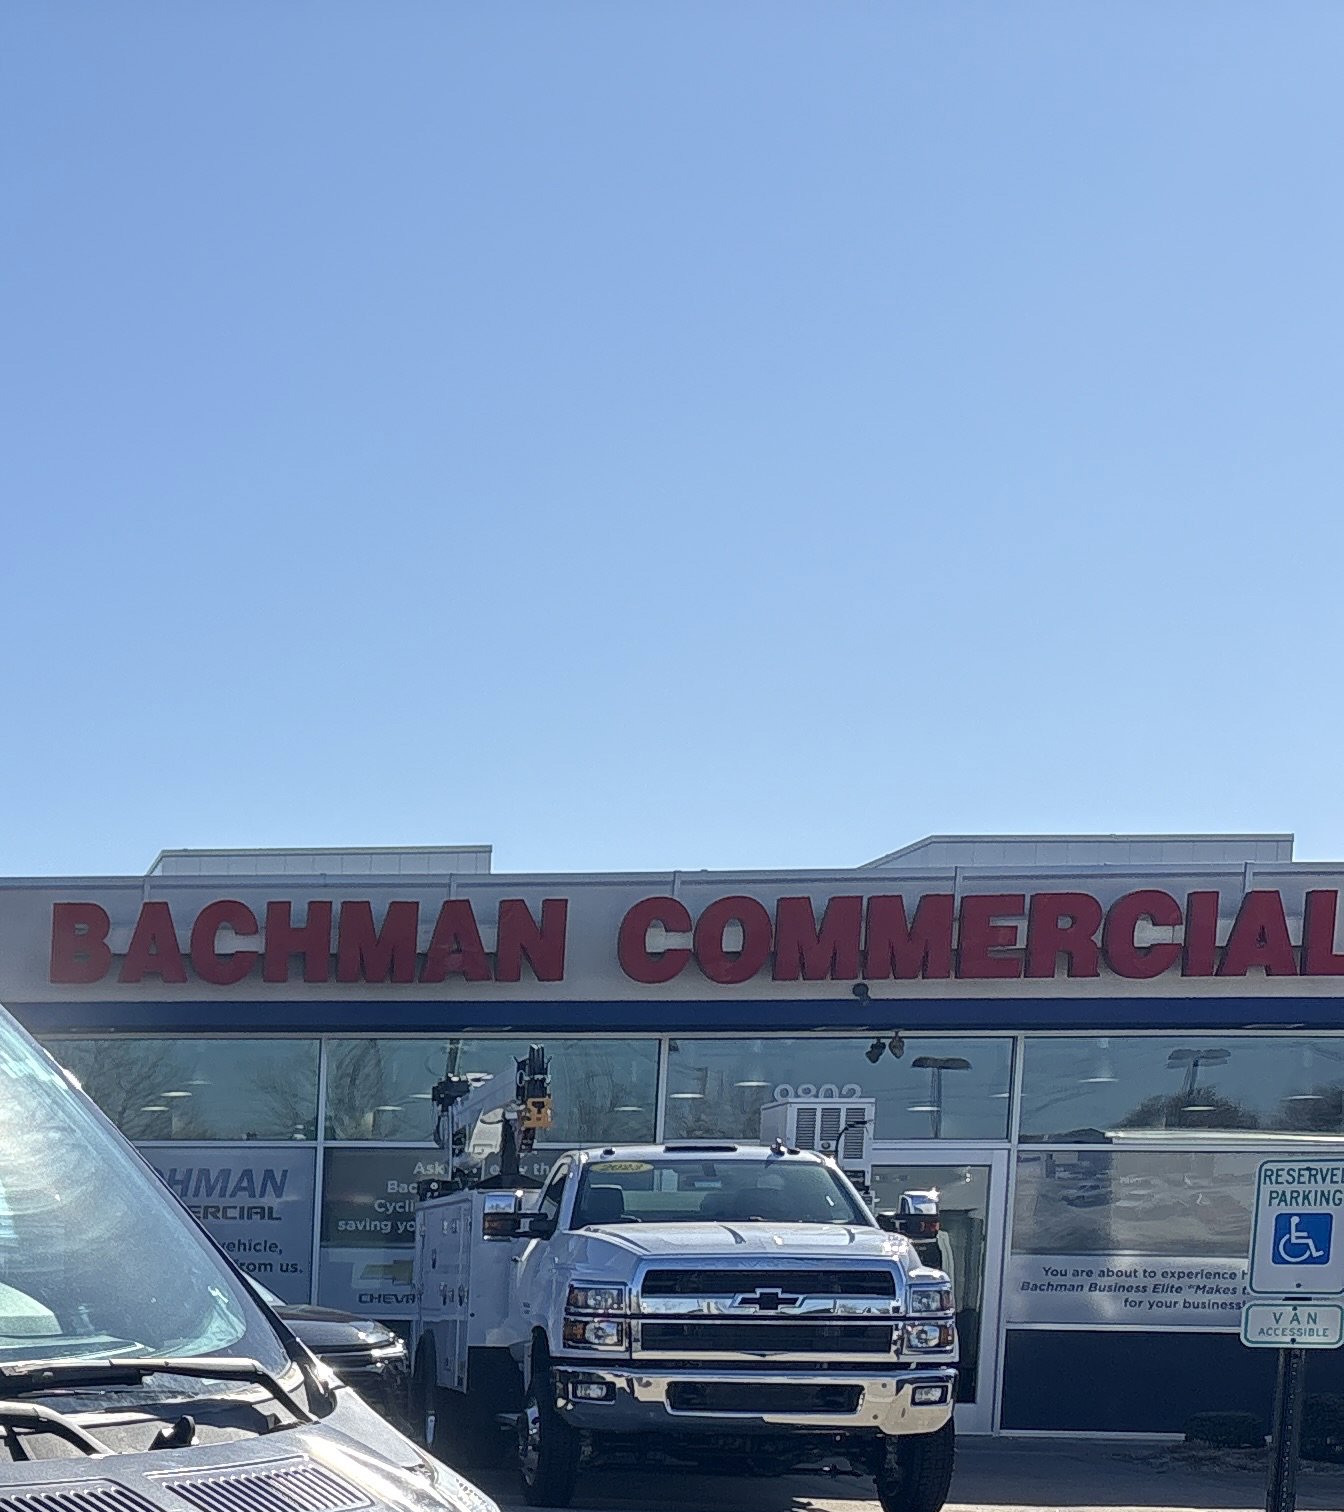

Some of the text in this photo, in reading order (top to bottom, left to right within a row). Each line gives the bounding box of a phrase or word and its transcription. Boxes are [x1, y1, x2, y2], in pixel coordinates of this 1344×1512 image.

[50, 888, 1344, 986] BACHMAN COMMERCIAL
[413, 1162, 446, 1175] Ask
[155, 1167, 288, 1198] HMAN
[1268, 1189, 1343, 1207] PARKING
[188, 1205, 282, 1221] ERCIAL
[374, 1199, 415, 1215] Cycli
[338, 1218, 416, 1234] saving yo
[279, 1262, 303, 1273] us.
[1042, 1266, 1068, 1277] You
[1072, 1268, 1094, 1278] are
[1098, 1267, 1139, 1279] about
[1143, 1268, 1157, 1279] to
[1160, 1269, 1238, 1281] experience
[1020, 1281, 1084, 1292] Bachman
[1088, 1282, 1148, 1294] Business
[1152, 1283, 1184, 1294] Elite
[358, 1293, 416, 1304] CHEVR
[1123, 1297, 1144, 1308] for
[1148, 1299, 1179, 1311] your
[1272, 1311, 1318, 1326] VAN
[1258, 1327, 1330, 1338] ACCESSIBLE
